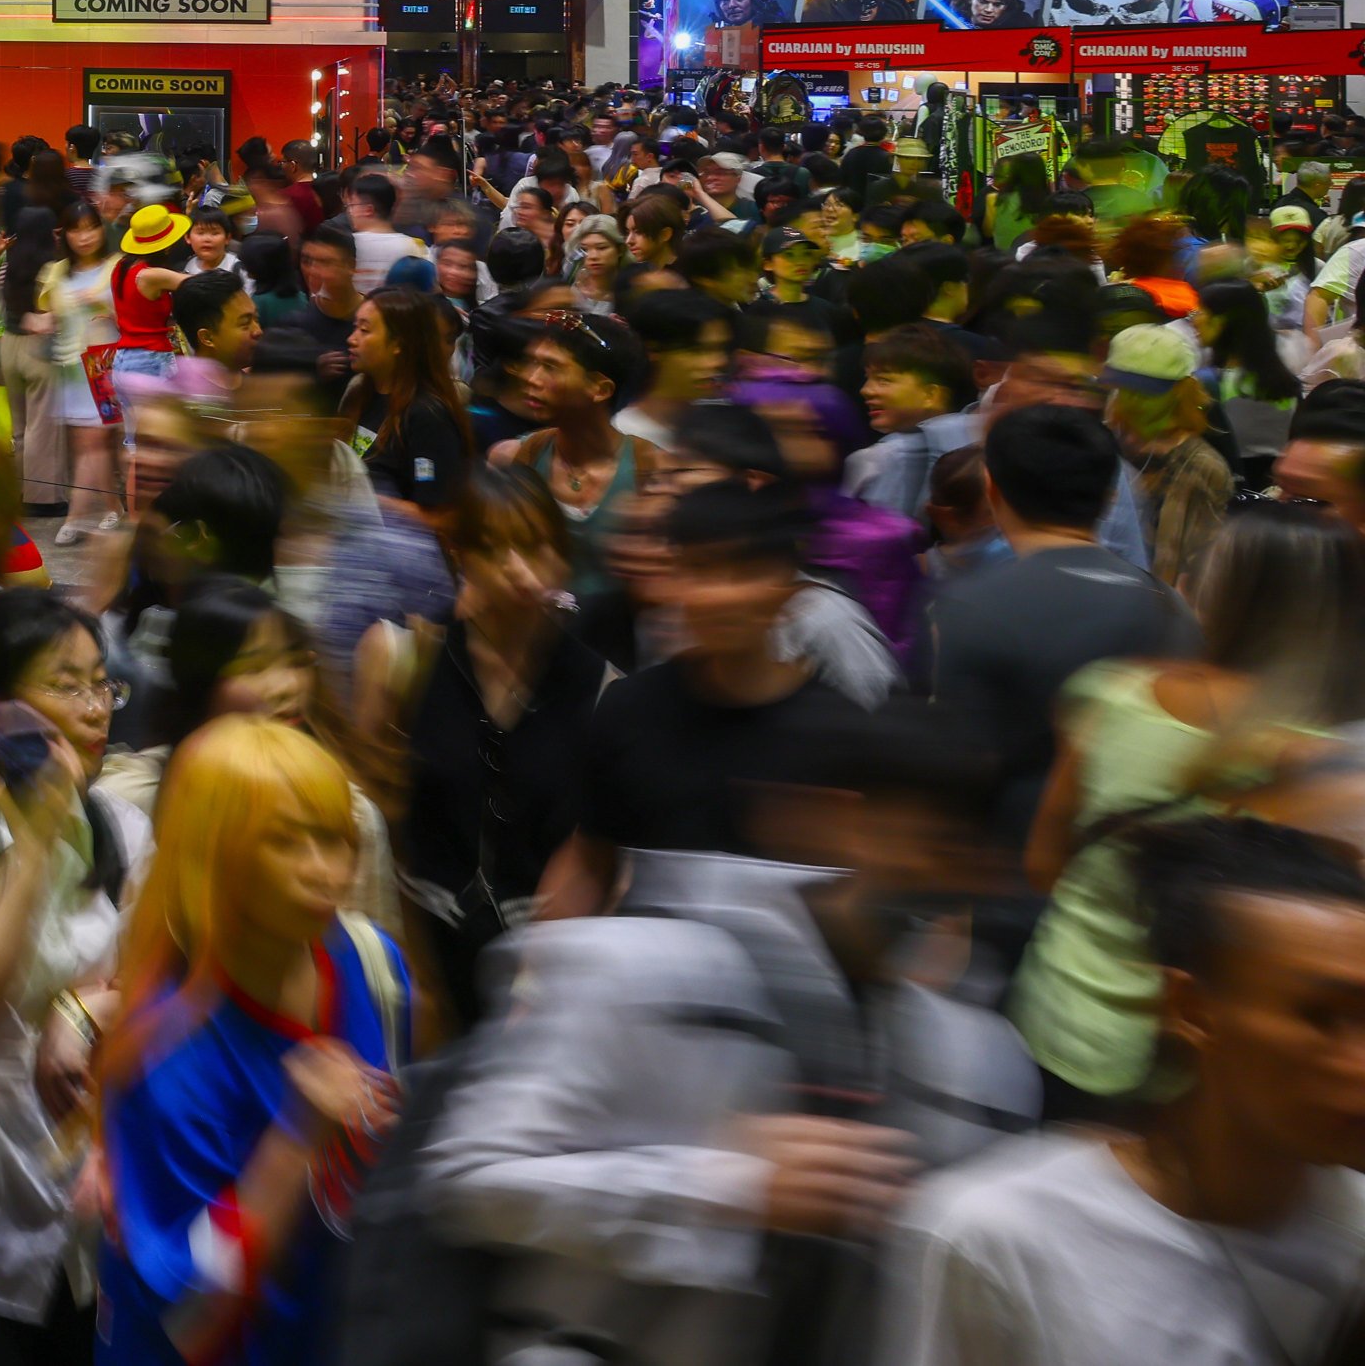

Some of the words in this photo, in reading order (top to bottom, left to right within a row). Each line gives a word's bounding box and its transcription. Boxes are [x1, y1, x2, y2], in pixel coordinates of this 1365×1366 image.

[403, 5, 417, 13] EXIT
[510, 6, 524, 14] EXIT
[768, 42, 832, 54] CHARAJAN
[836, 43, 852, 56] by
[855, 43, 925, 55] MARUSHIN
[1079, 45, 1148, 57] CHARAJAN
[1151, 45, 1168, 59] by
[1172, 46, 1247, 57] MARUSHIN
[95, 78, 164, 91] COMING
[169, 79, 218, 91] SOON
[1015, 130, 1030, 140] THE
